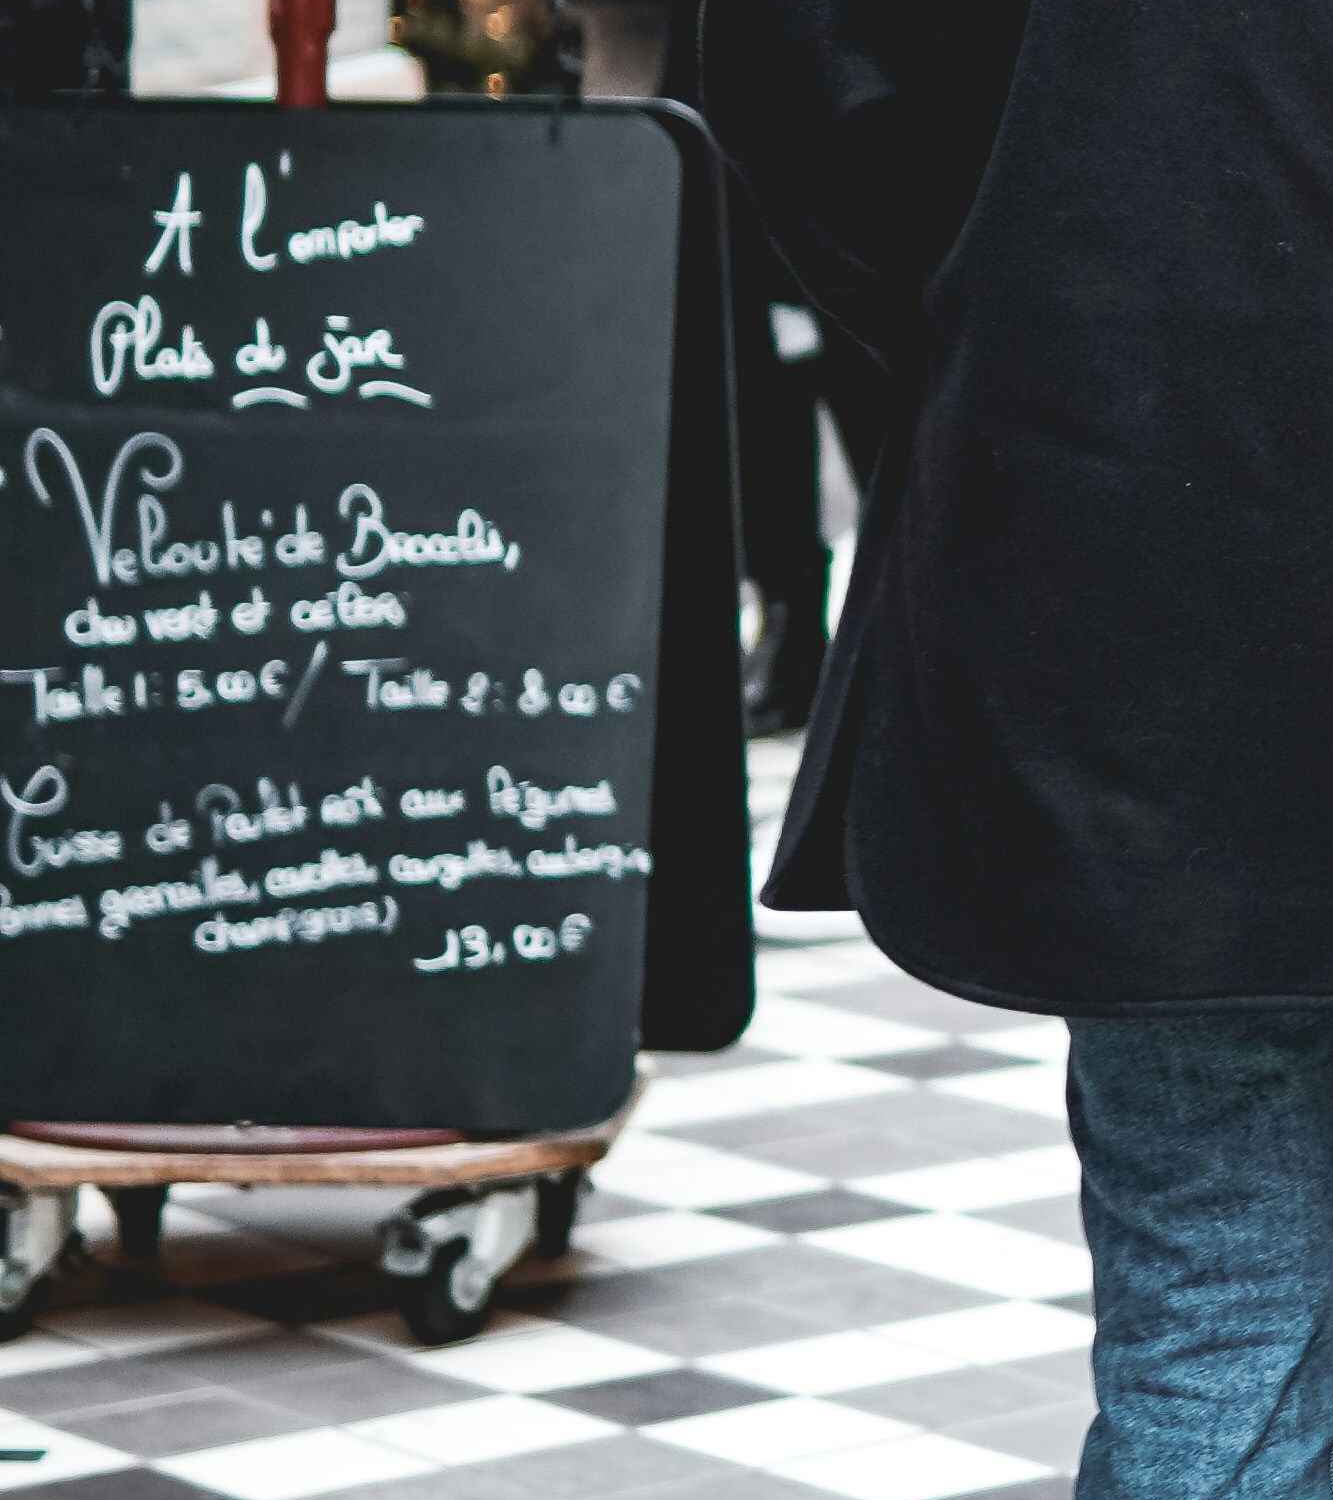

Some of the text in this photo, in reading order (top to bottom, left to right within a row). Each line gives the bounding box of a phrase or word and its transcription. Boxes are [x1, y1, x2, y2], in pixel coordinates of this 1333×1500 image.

[143, 170, 204, 276] A
[235, 315, 290, 378] du
[275, 502, 327, 568] de
